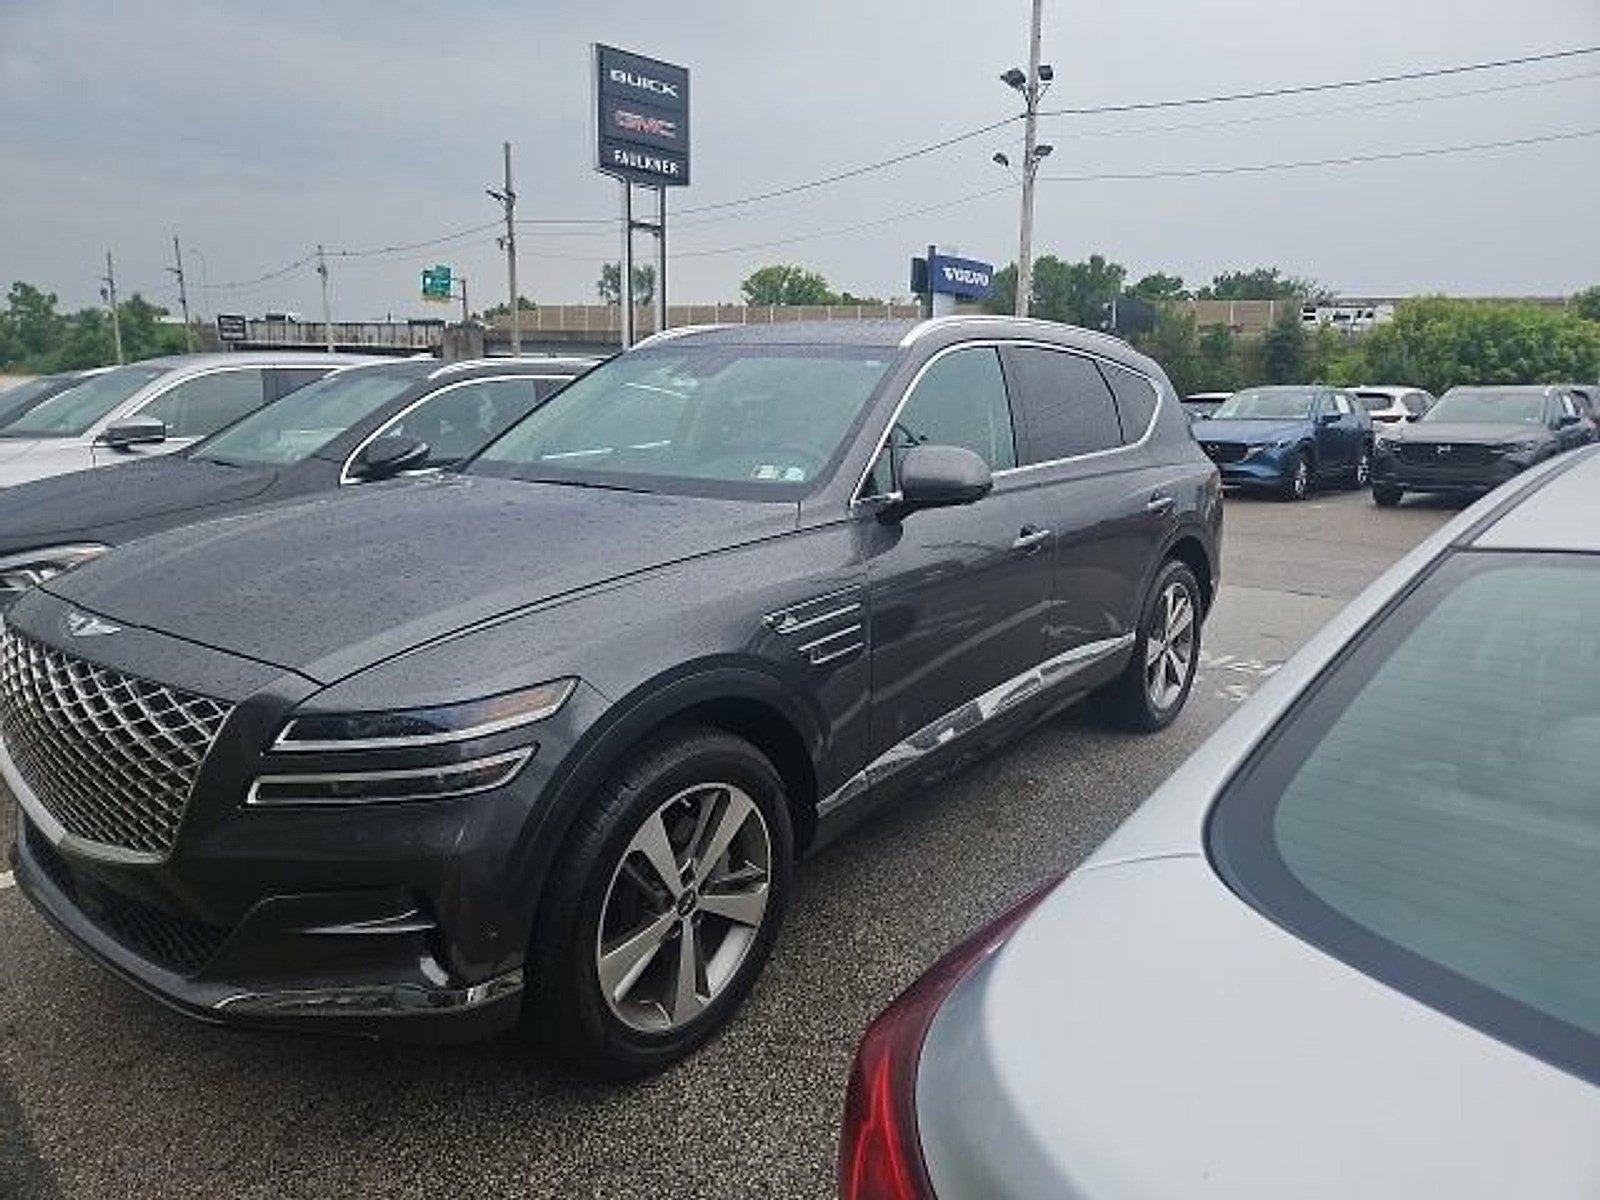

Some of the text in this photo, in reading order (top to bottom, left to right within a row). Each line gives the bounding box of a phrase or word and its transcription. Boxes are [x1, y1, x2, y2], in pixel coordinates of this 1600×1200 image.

[609, 69, 679, 98] BUICK
[614, 109, 677, 138] GMC
[614, 149, 679, 174] FAULKNER
